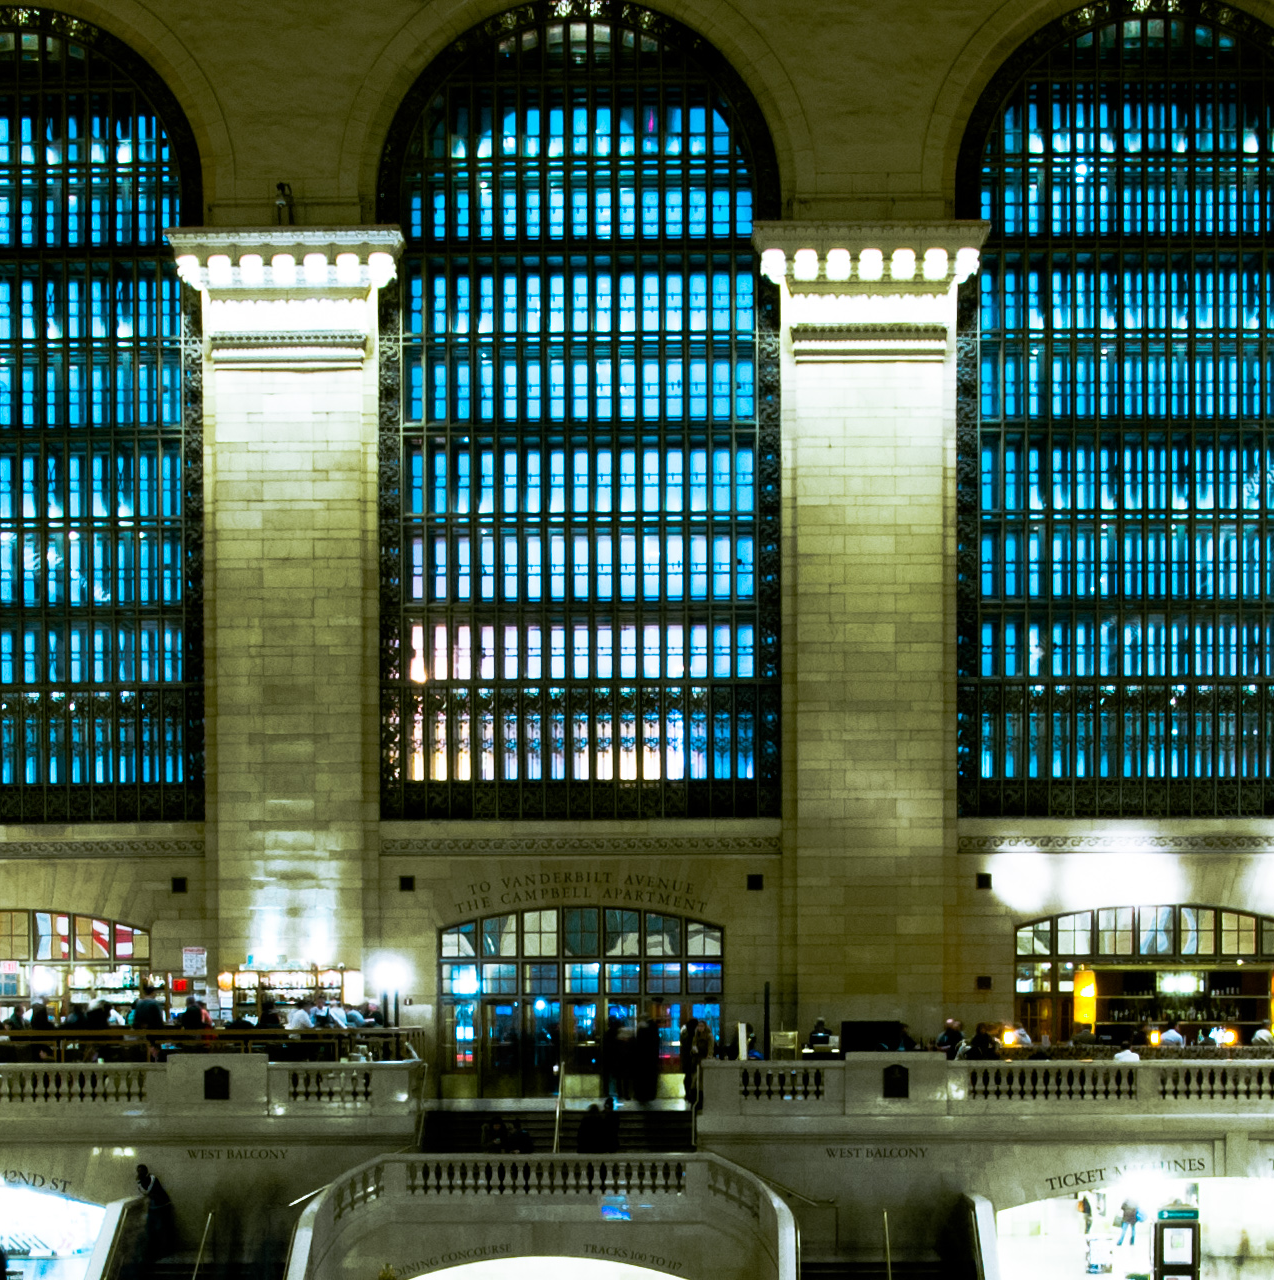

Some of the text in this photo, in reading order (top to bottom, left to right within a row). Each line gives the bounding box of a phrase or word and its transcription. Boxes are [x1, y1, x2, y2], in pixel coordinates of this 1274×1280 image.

[467, 871, 695, 896] TO VANDERBILT AVENUE
[454, 887, 708, 914] THE CAMPBELL APARTMENT
[187, 1148, 288, 1160] WEST BALCONY
[825, 1147, 928, 1159] WEST BALCONY
[2, 1169, 46, 1188] 42ND
[49, 1177, 73, 1193] ST
[1045, 1158, 1206, 1191] TICKET MINES
[395, 1243, 512, 1277] DINING CONCOURSE
[583, 1244, 683, 1271] TRACKS 100 TO 117
